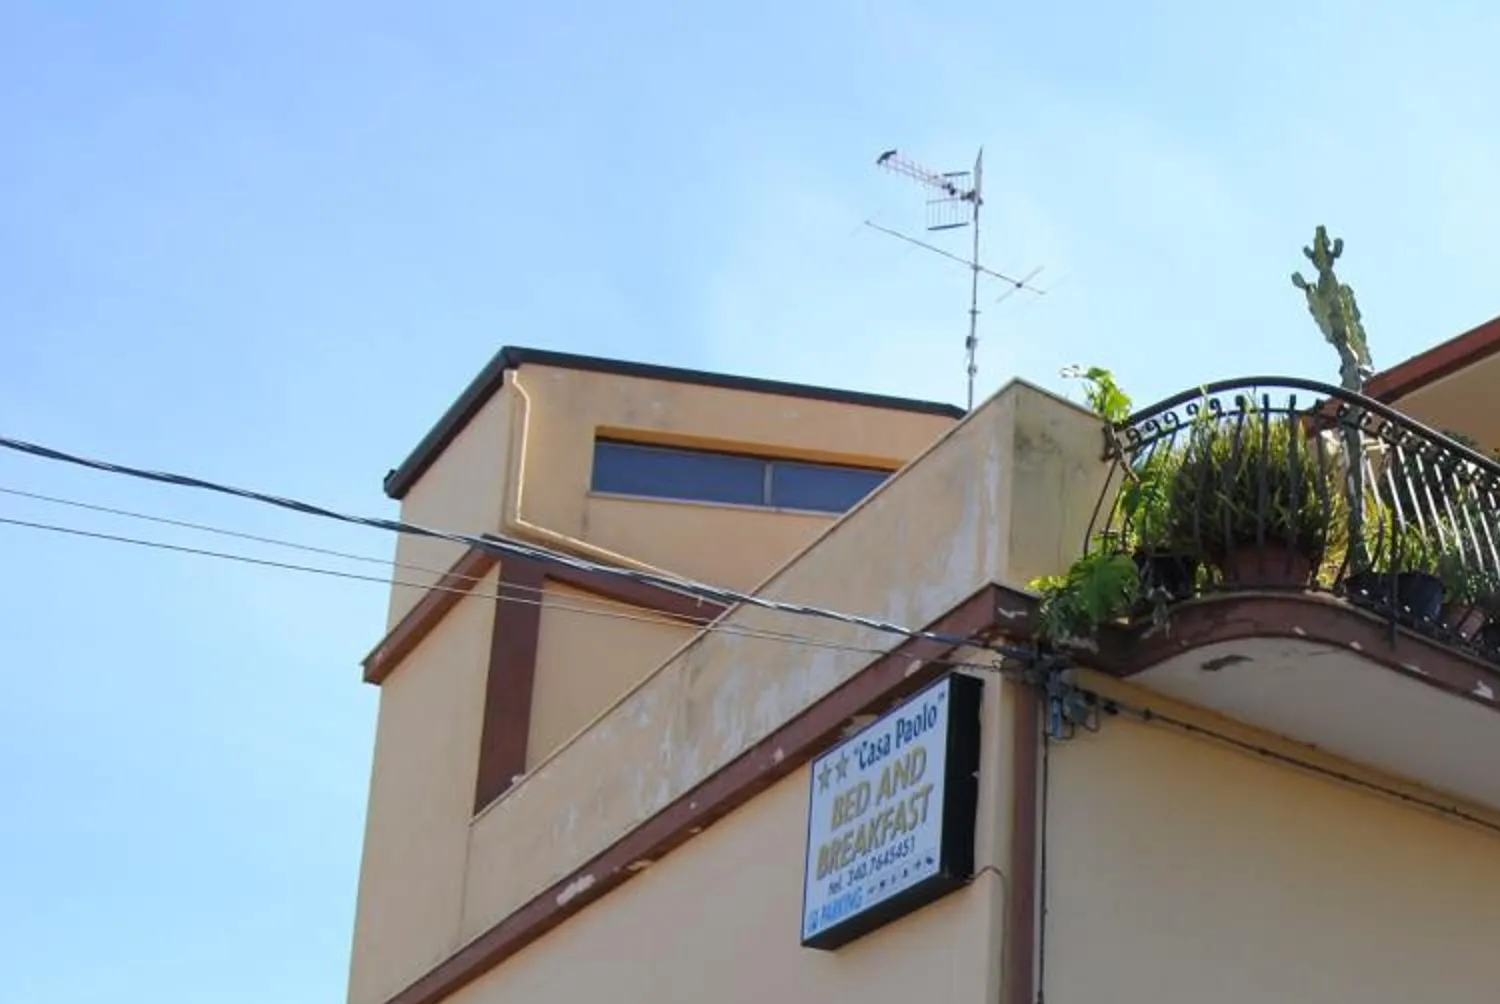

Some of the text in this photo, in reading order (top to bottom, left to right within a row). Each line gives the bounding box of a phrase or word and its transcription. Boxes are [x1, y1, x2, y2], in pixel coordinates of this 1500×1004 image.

[816, 784, 935, 881] BREAKFAST
[830, 745, 928, 832] BED AND
